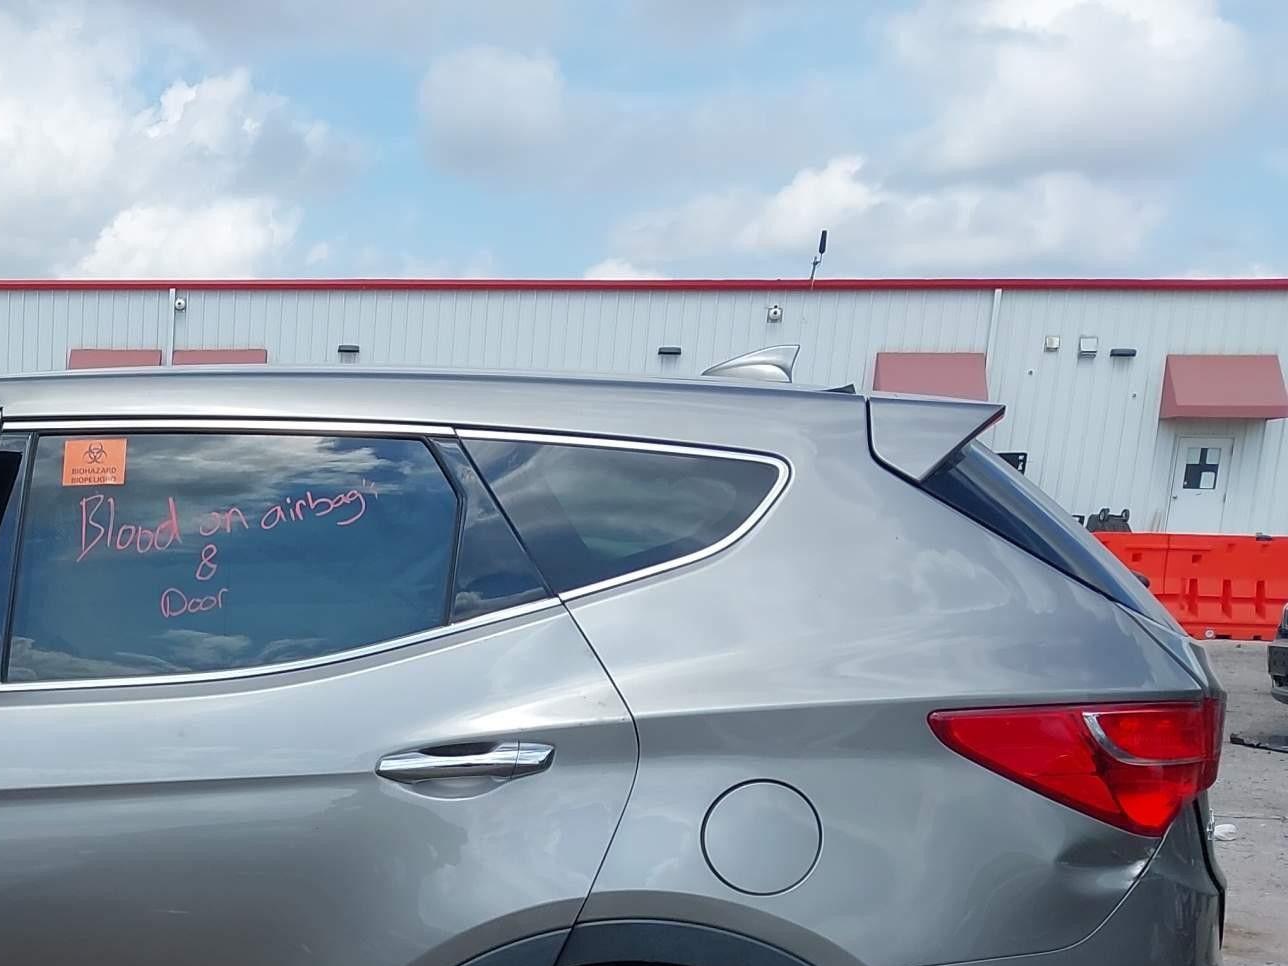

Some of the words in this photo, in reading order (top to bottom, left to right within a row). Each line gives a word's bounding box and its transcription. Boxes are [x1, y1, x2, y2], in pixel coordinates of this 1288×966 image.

[71, 467, 117, 475] BIOHAZARD
[76, 494, 183, 563] Blood
[199, 506, 249, 537] on
[160, 588, 229, 619] Door
